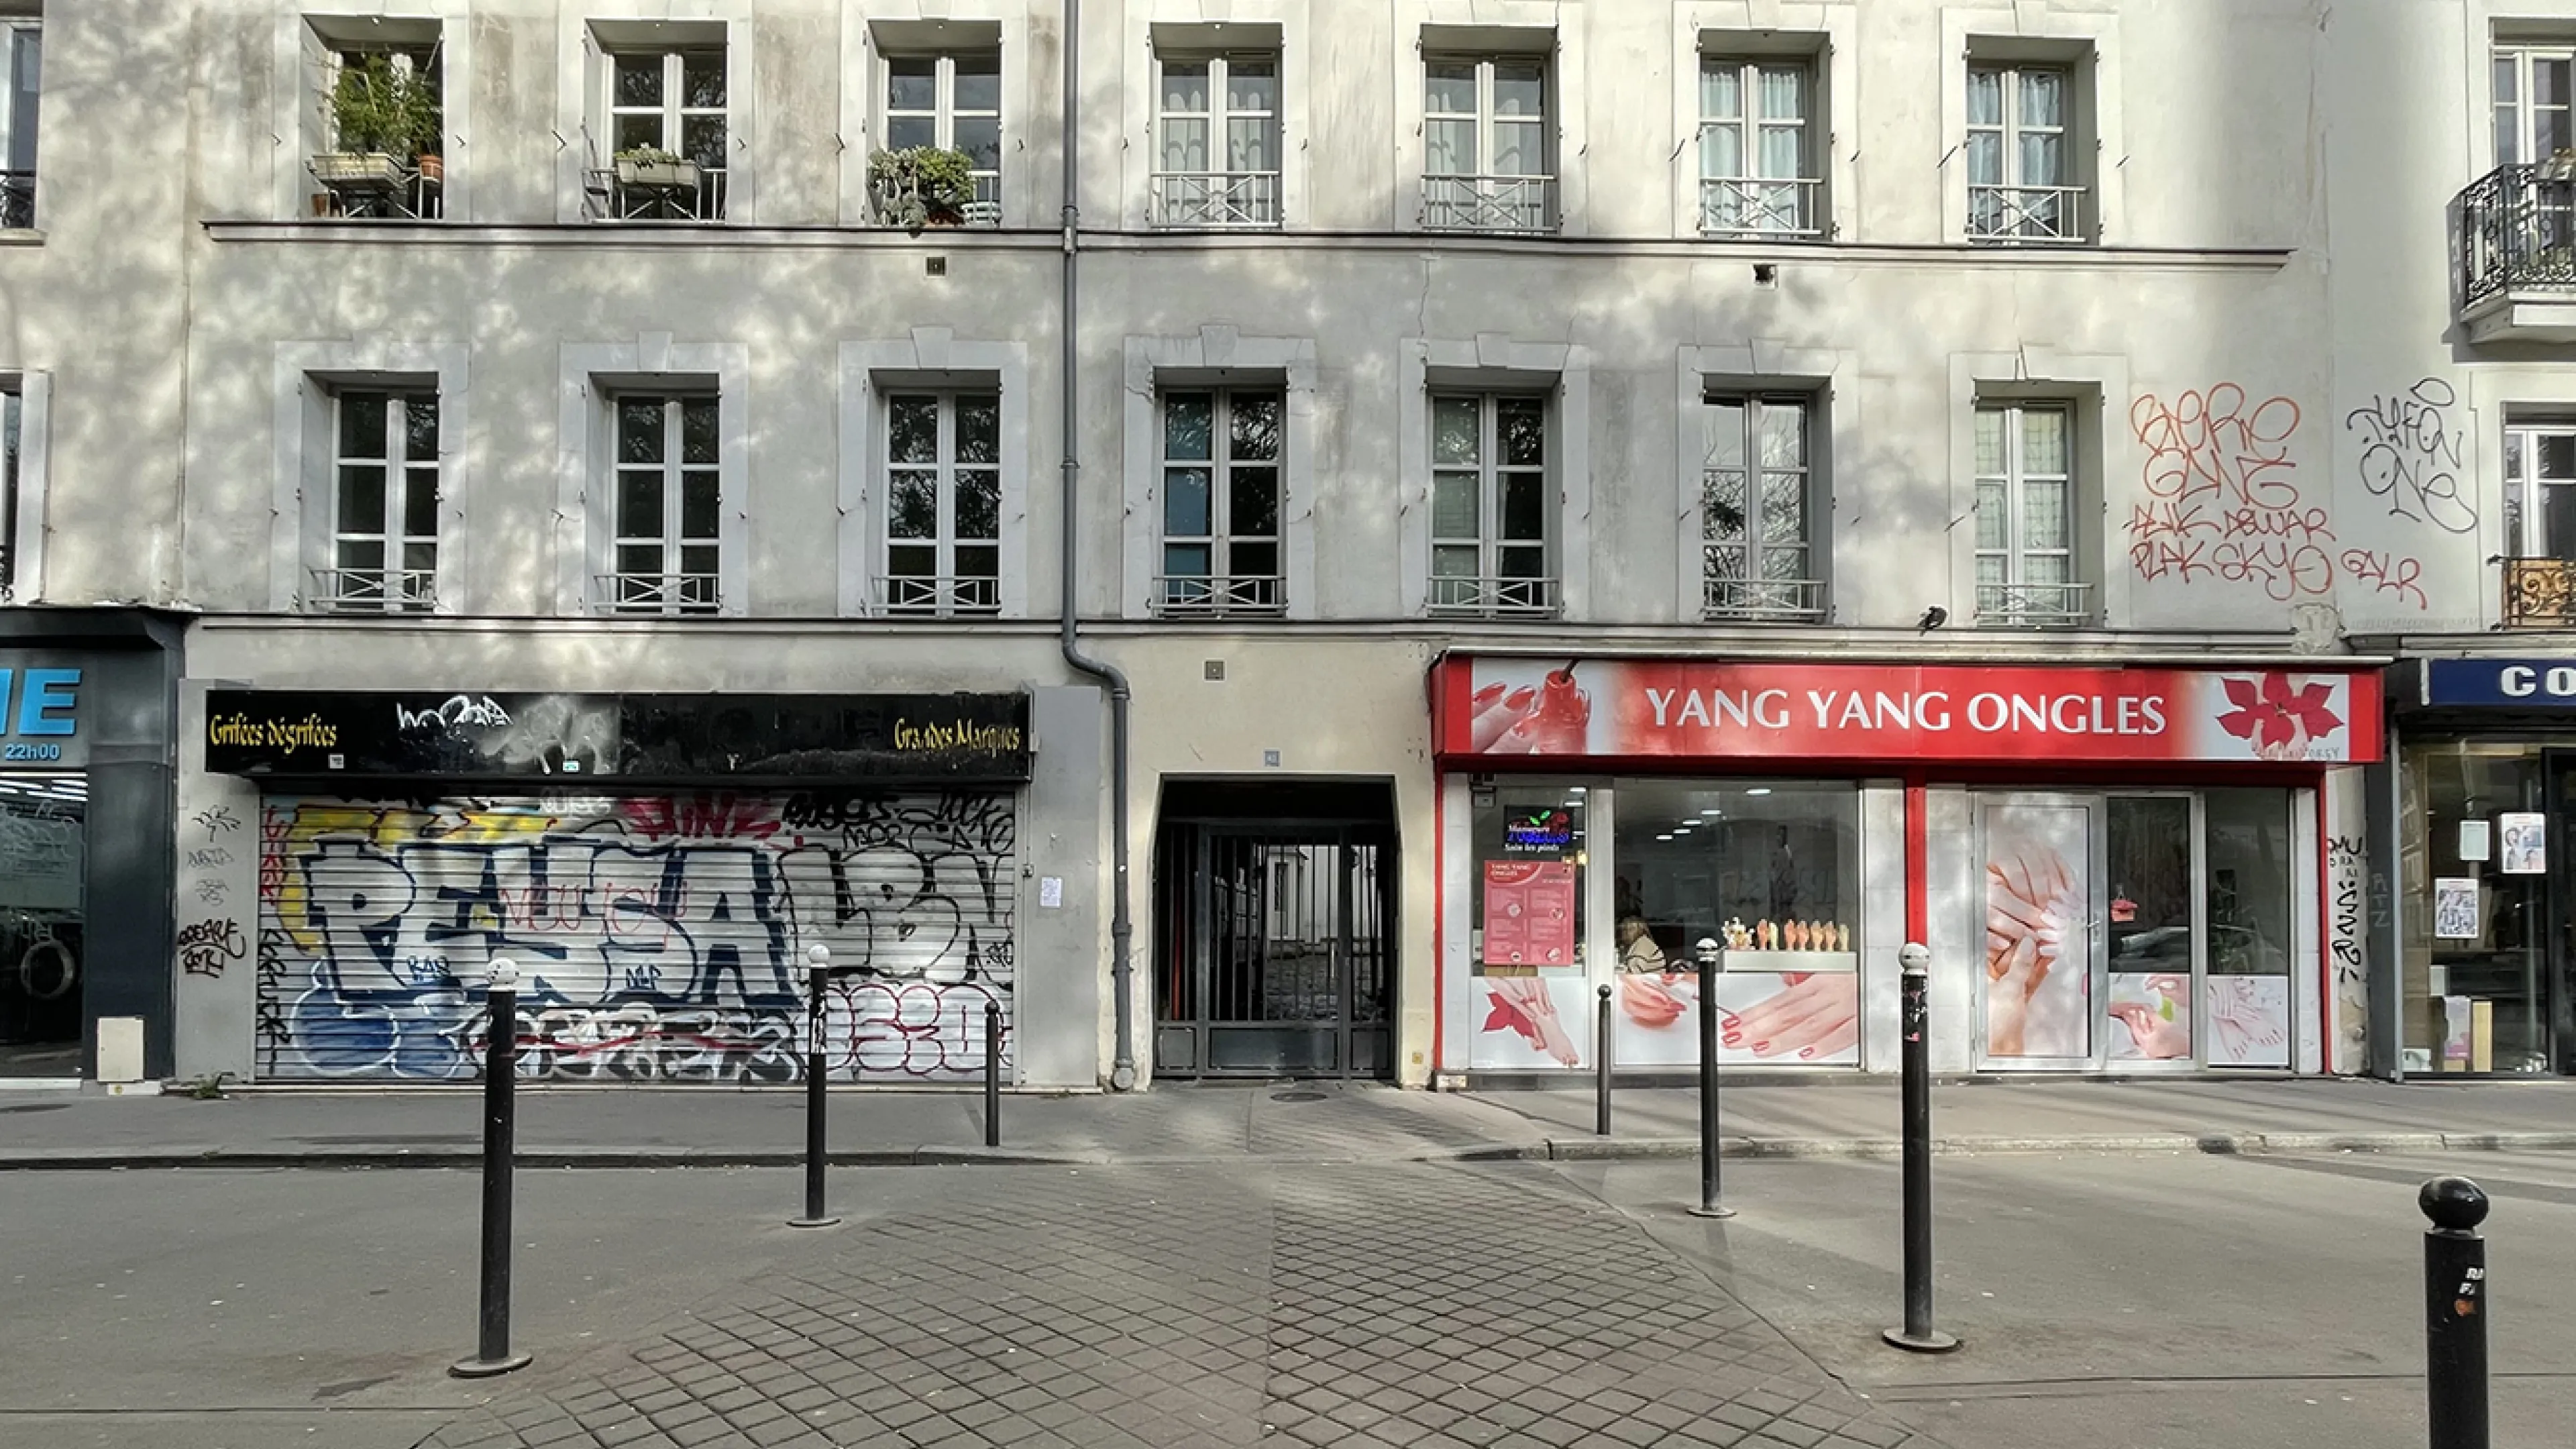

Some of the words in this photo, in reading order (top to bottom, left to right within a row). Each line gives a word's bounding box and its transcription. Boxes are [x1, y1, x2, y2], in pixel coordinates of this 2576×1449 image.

[0, 668, 81, 735] E
[1646, 688, 1790, 729] YANG
[1807, 691, 1950, 731] YANG
[1967, 694, 2167, 735] ONGLES
[5, 743, 60, 761] 22h00
